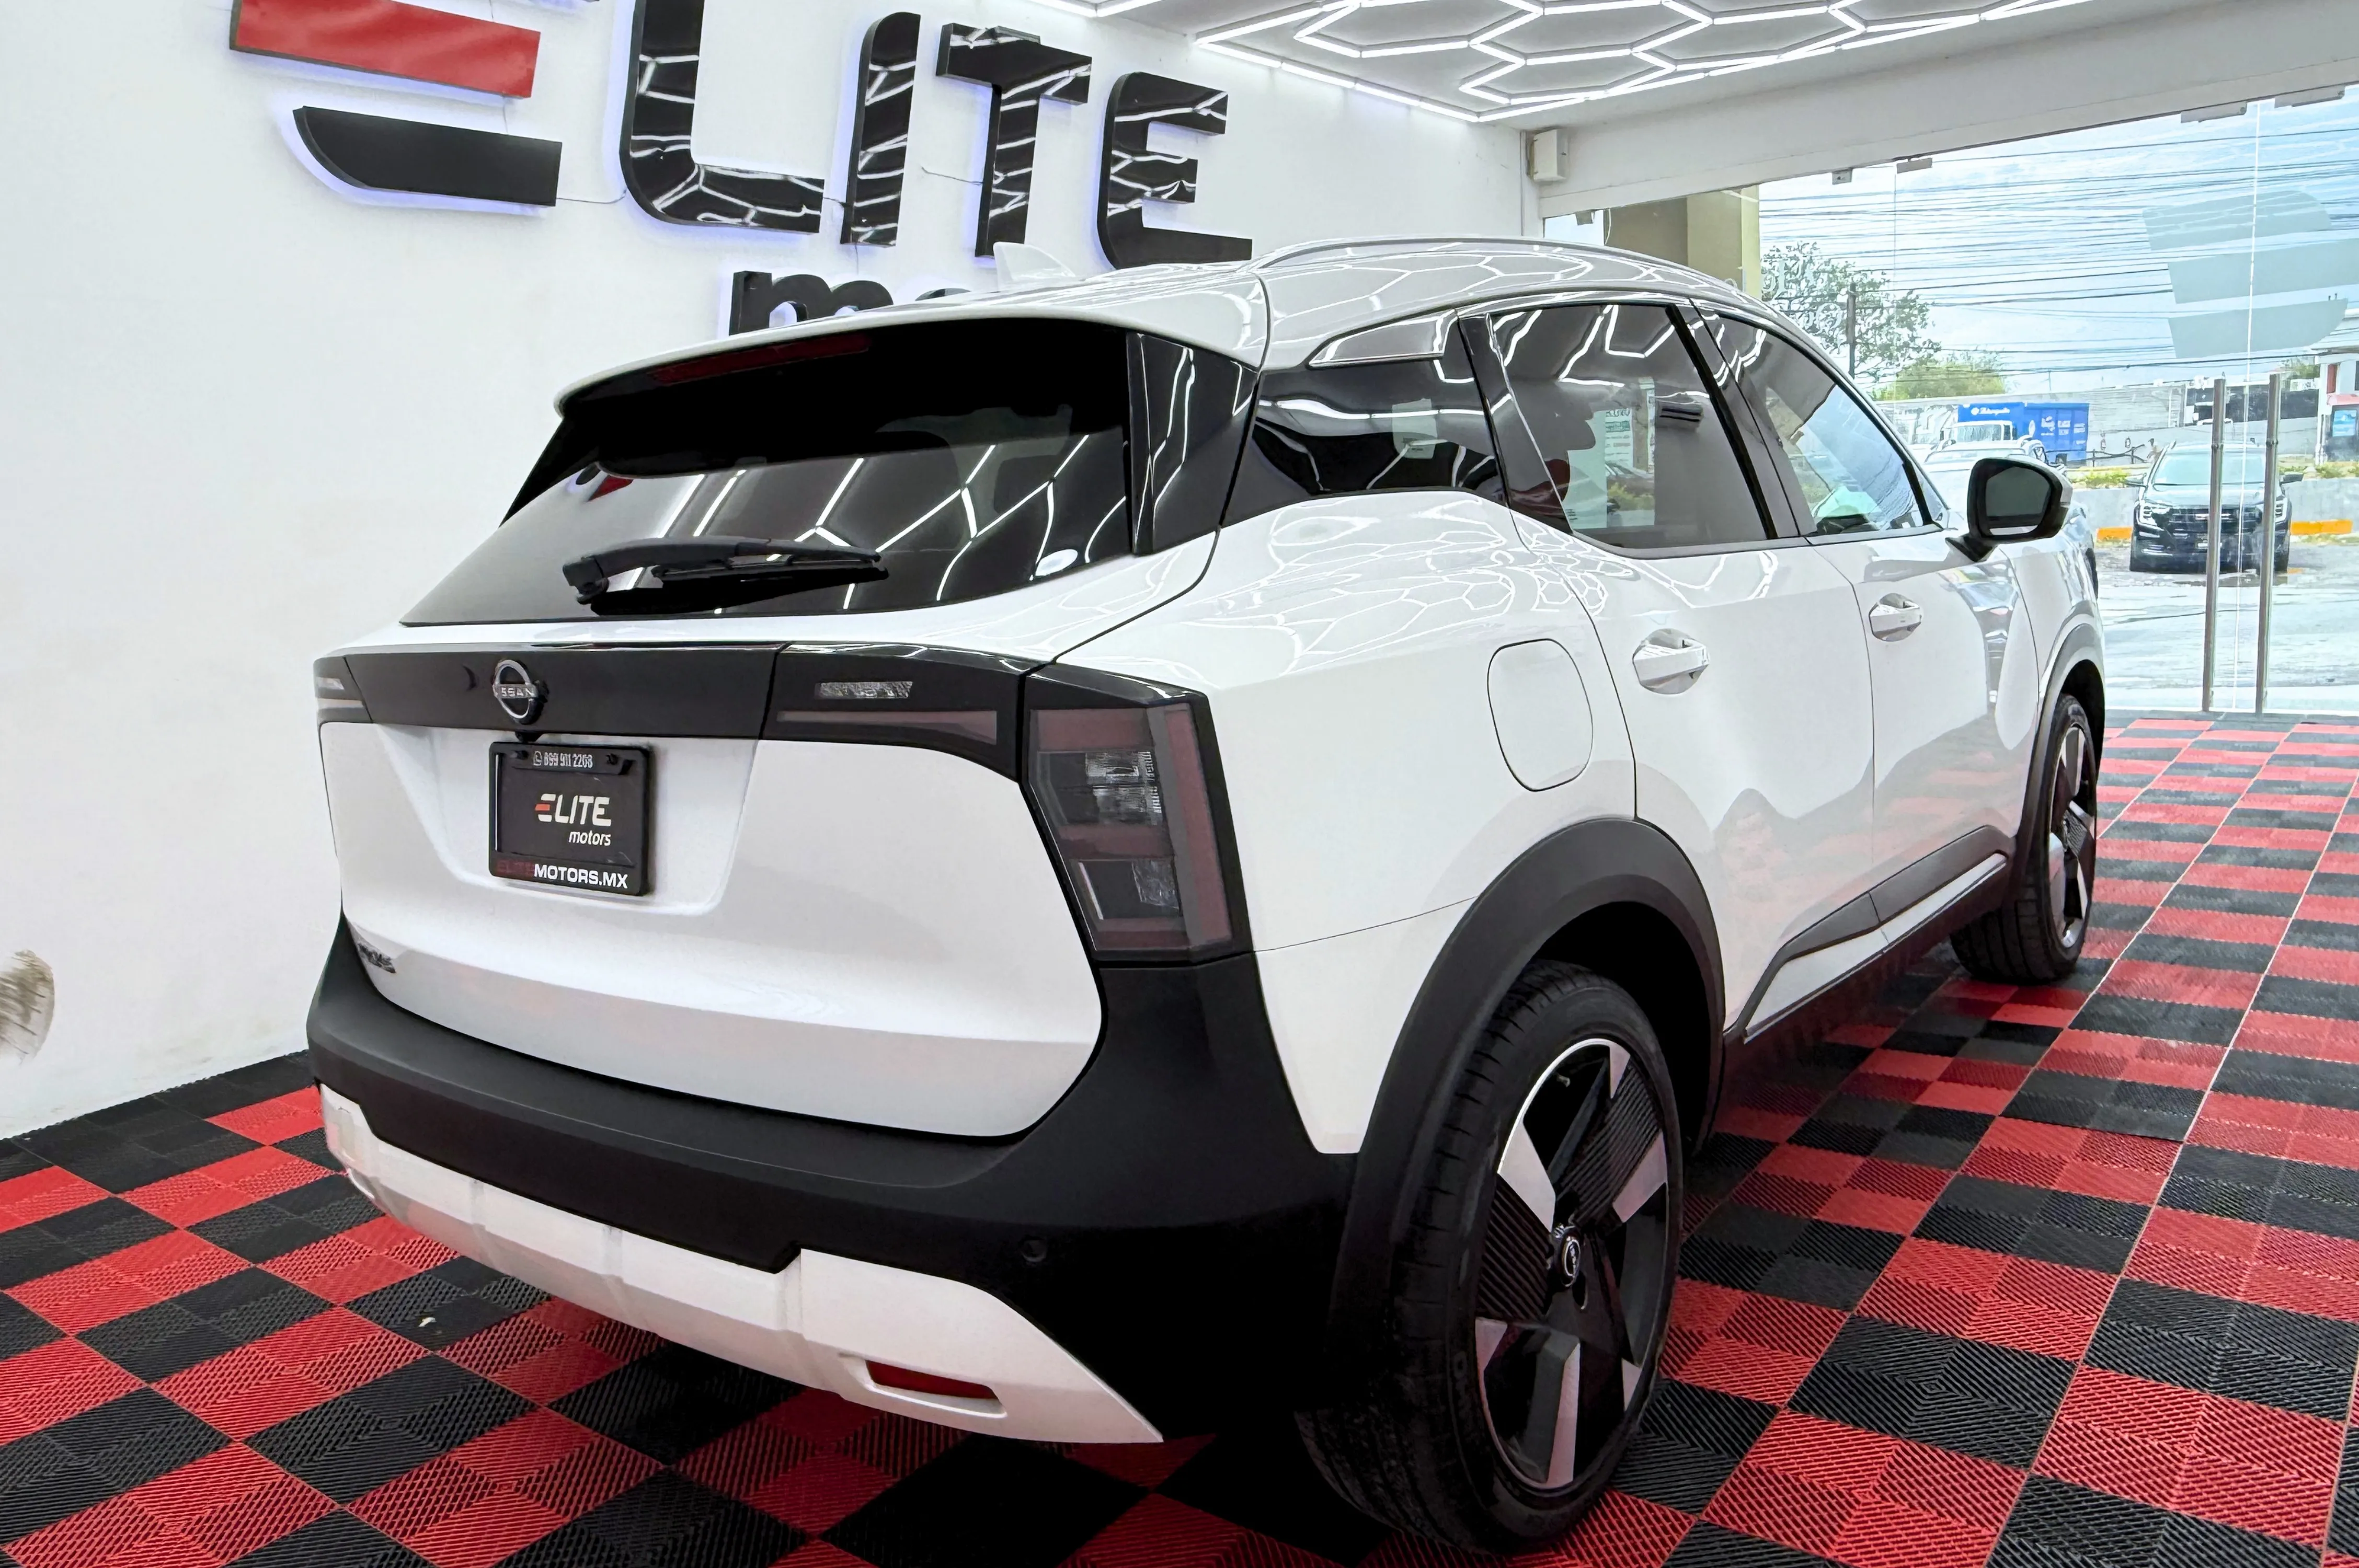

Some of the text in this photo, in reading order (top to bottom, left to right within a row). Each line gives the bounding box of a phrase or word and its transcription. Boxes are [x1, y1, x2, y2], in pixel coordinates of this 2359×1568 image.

[560, 753, 571, 767] 911
[535, 793, 612, 826] ELITE
[568, 830, 611, 846] motors
